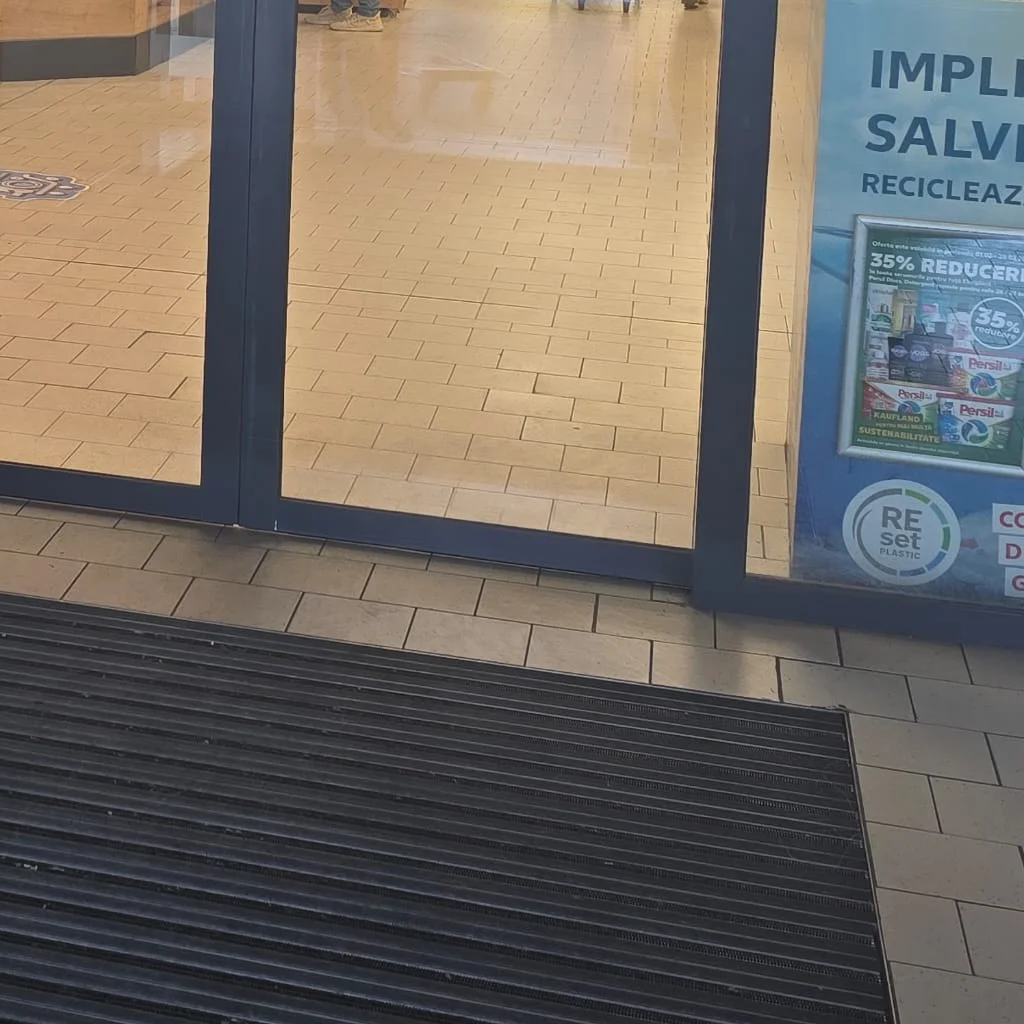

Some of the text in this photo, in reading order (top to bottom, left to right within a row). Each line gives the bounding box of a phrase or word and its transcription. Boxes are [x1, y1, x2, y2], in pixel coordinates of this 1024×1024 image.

[862, 173, 1024, 206] RECICLEAZ
[870, 252, 915, 271] 35%
[975, 307, 1021, 333] 35%
[968, 357, 1003, 371] Persil
[898, 388, 925, 400] Persil
[873, 411, 921, 423] KAUFLAND
[959, 404, 995, 418] Persil
[859, 426, 940, 444] SUSTENABILITATE
[882, 506, 922, 532] RE
[880, 532, 921, 549] set
[880, 548, 920, 559] PLASTIC
